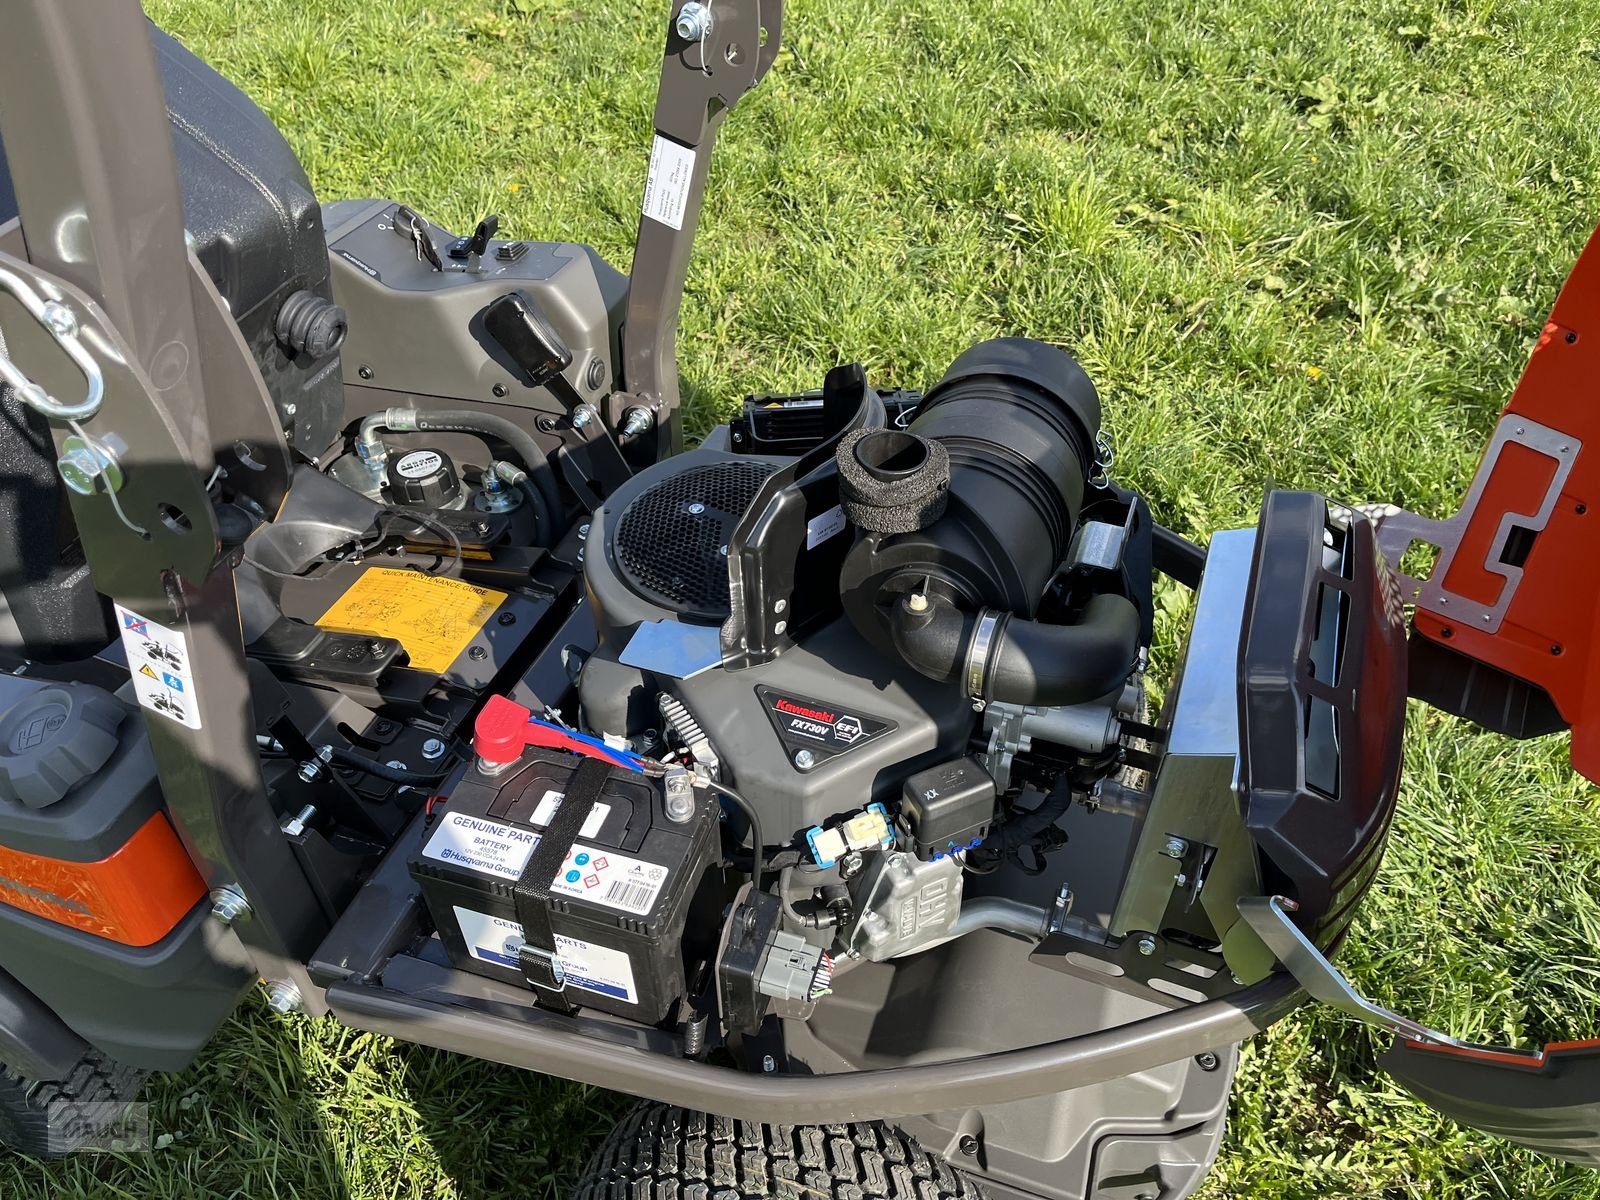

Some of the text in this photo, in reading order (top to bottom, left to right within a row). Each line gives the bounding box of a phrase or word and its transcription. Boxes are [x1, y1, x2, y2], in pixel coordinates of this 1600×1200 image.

[405, 572, 461, 589] MAINTENANCE
[462, 584, 488, 596] GUIDE
[775, 699, 835, 723] Kawasaki
[790, 718, 829, 735] FX730V
[836, 722, 859, 735] EFI
[453, 816, 541, 846] GENUINE PART
[473, 836, 512, 852] BATTERY
[449, 851, 520, 877] Husqvarna Group
[493, 919, 524, 932] GENU
[553, 936, 588, 950] ARTS
